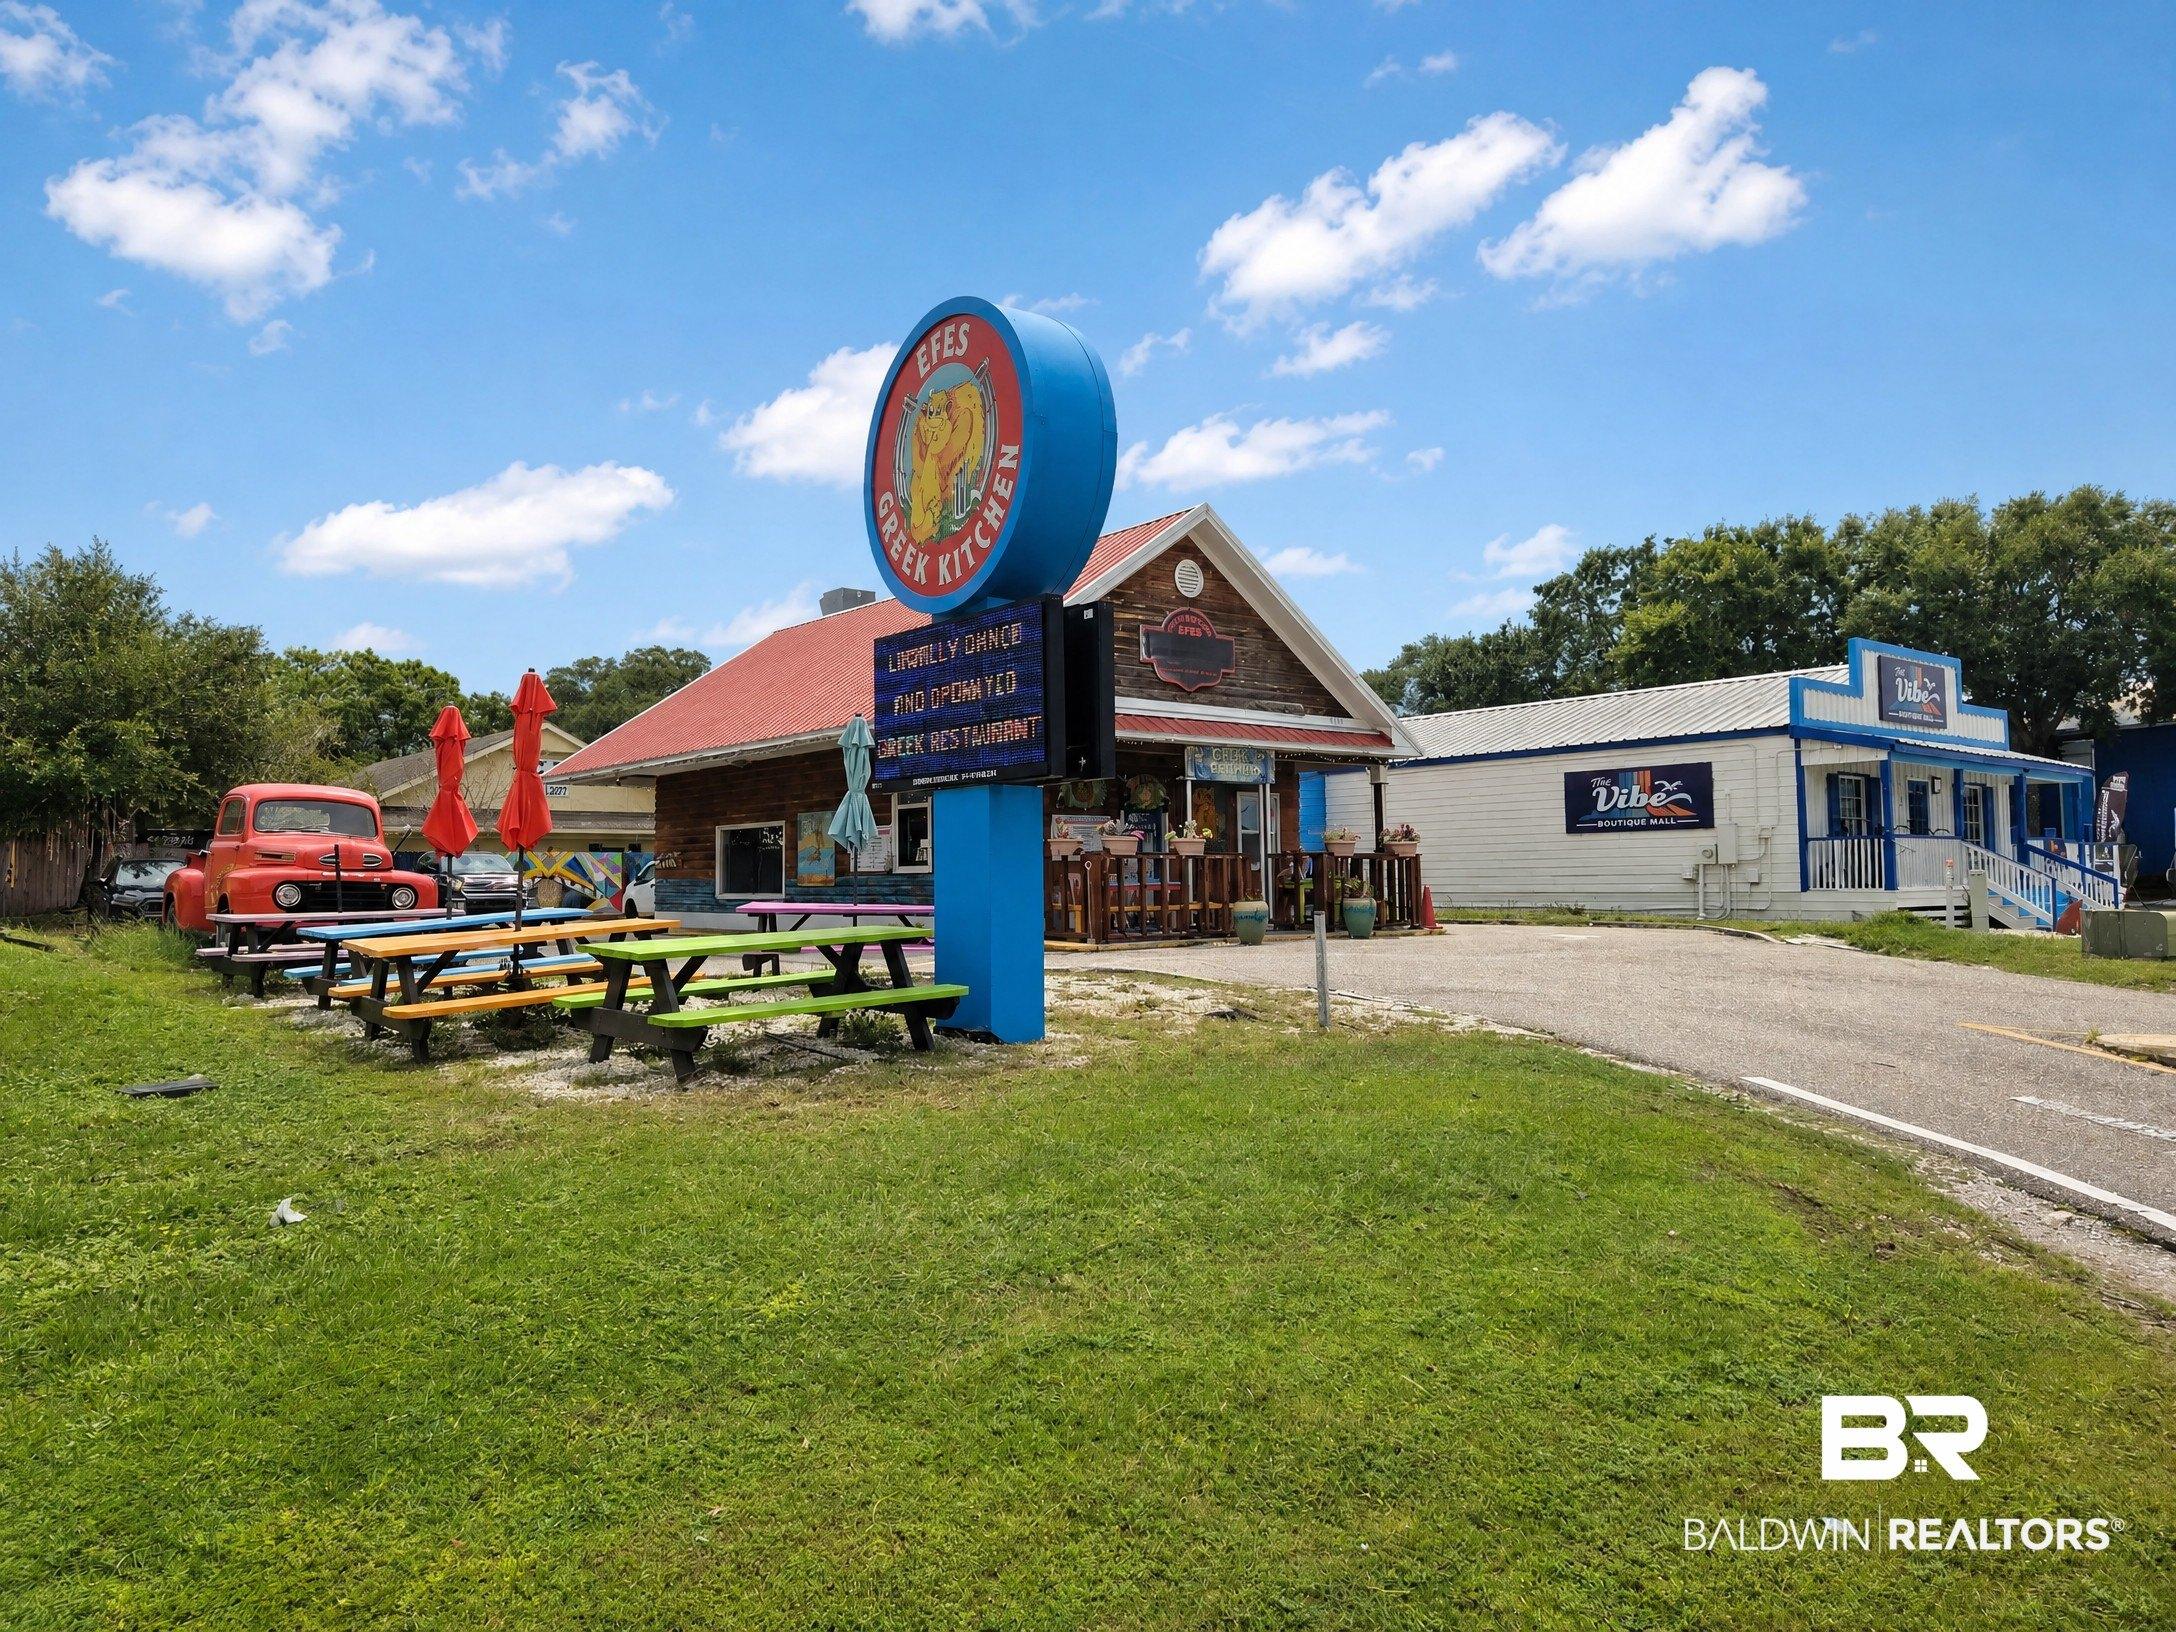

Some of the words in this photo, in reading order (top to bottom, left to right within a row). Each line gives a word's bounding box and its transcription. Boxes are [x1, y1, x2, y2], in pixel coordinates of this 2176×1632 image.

[916, 322, 970, 379] EFES
[878, 491, 928, 586] GREEK
[937, 444, 1021, 586] KITCHEN
[1895, 677, 1940, 704] Vibe
[1592, 785, 1693, 812] Vibe
[1597, 818, 1647, 828] BOUTIQUE
[1650, 817, 1677, 826] MALL
